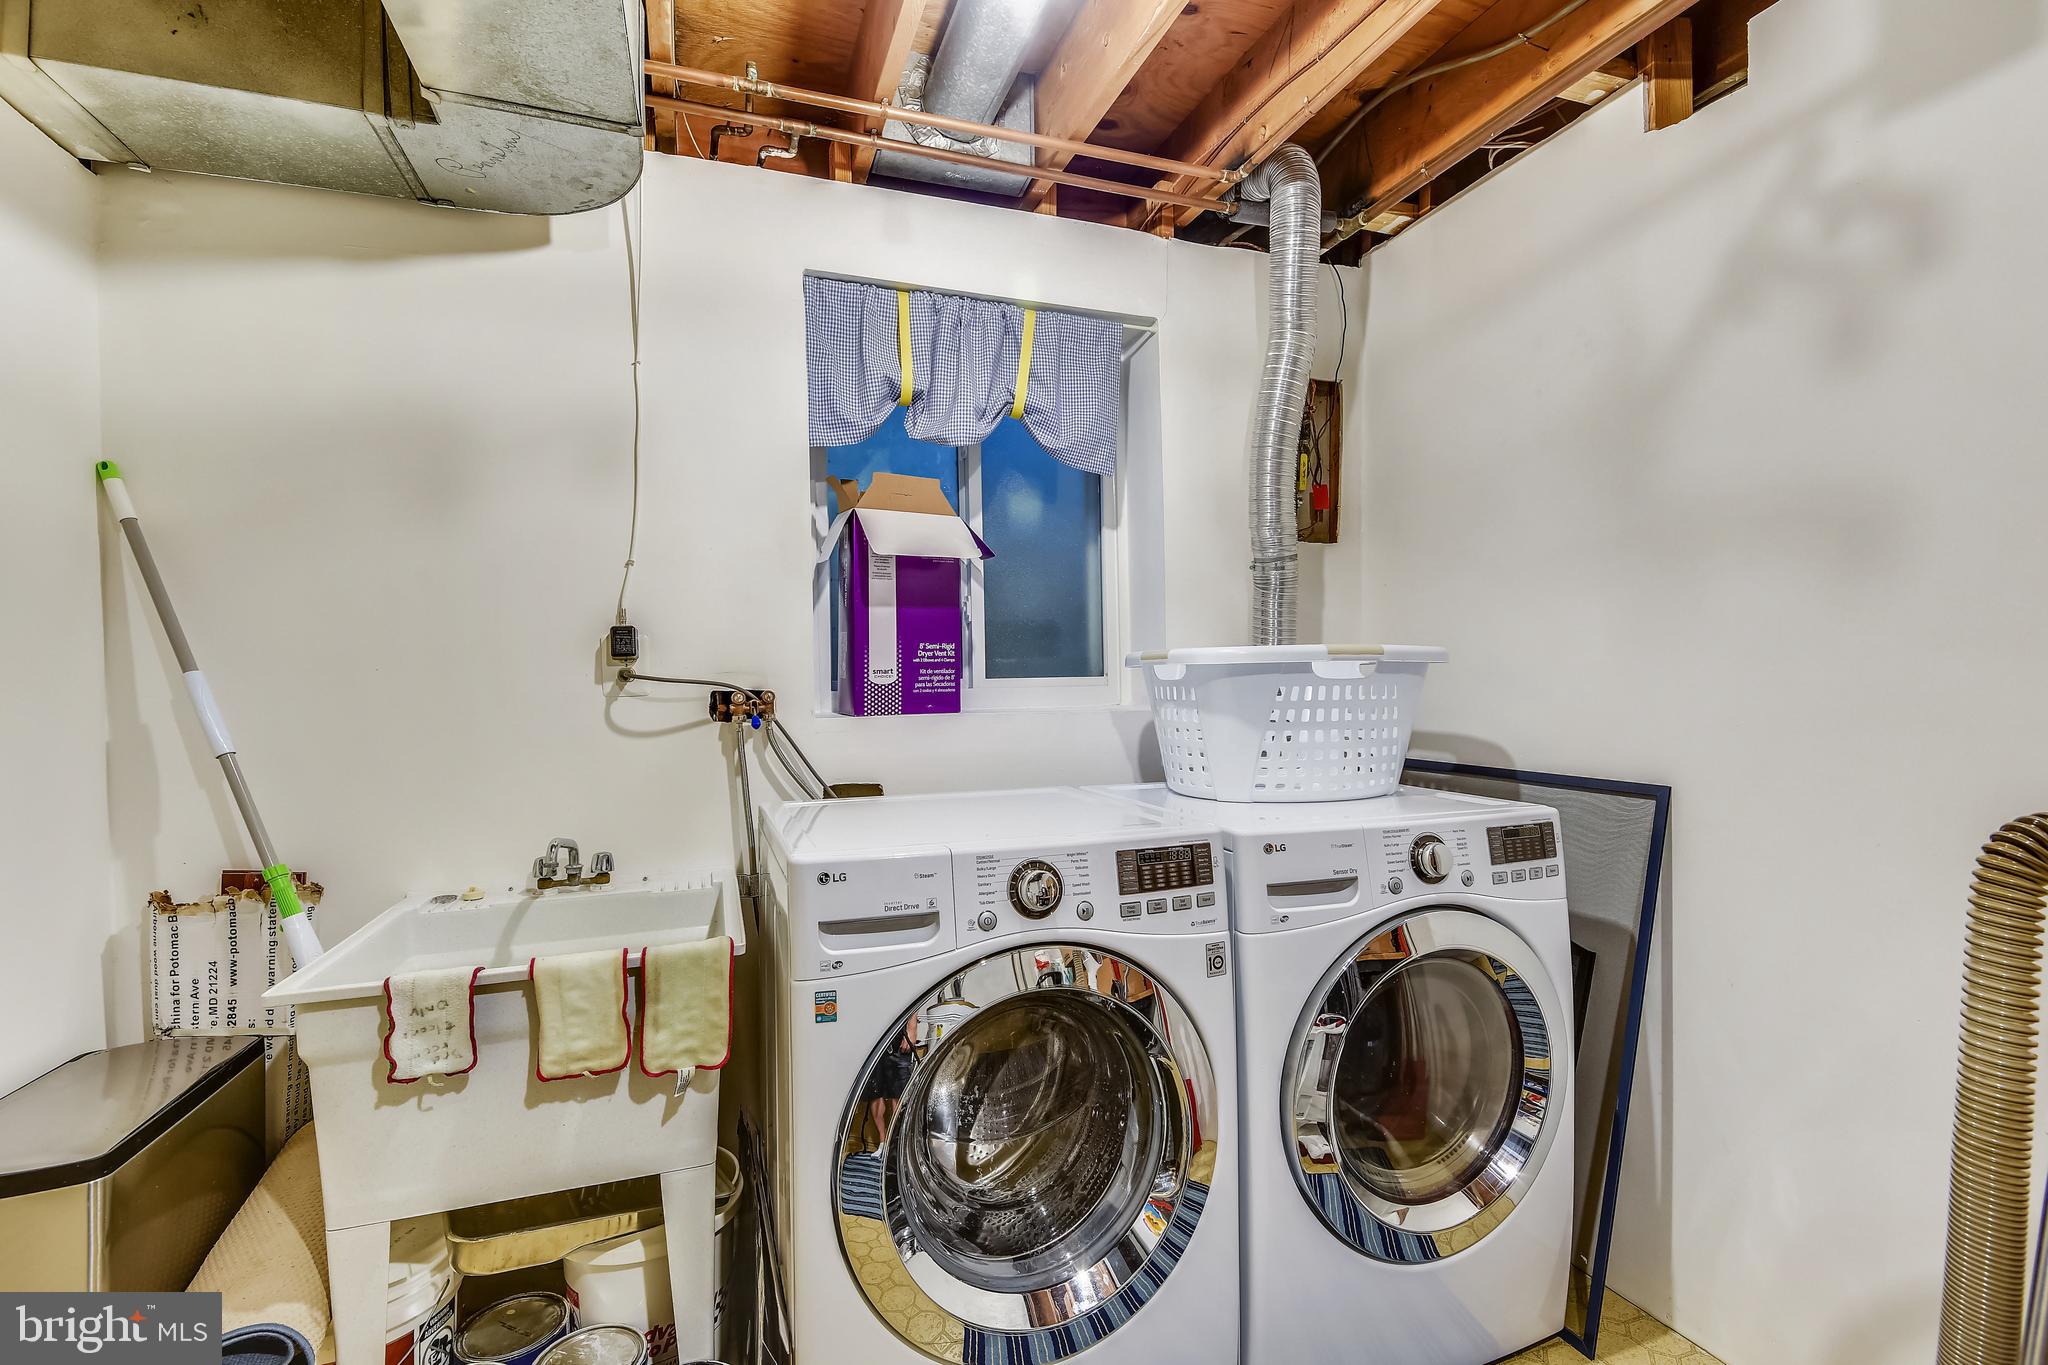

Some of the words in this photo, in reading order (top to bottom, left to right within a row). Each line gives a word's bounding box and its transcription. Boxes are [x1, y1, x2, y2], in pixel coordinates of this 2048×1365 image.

[926, 643, 955, 651] Semi-Rigid
[1275, 844, 1286, 852] LG
[832, 872, 847, 883] LG
[1349, 867, 1357, 875] Dry
[903, 903, 920, 911] Drive
[169, 925, 179, 977] Potomac
[266, 940, 278, 987] warning
[1208, 955, 1224, 971] 10
[208, 960, 218, 994] 21224
[170, 979, 180, 996] for
[190, 978, 199, 1000] Ave
[292, 1083, 301, 1116] should
